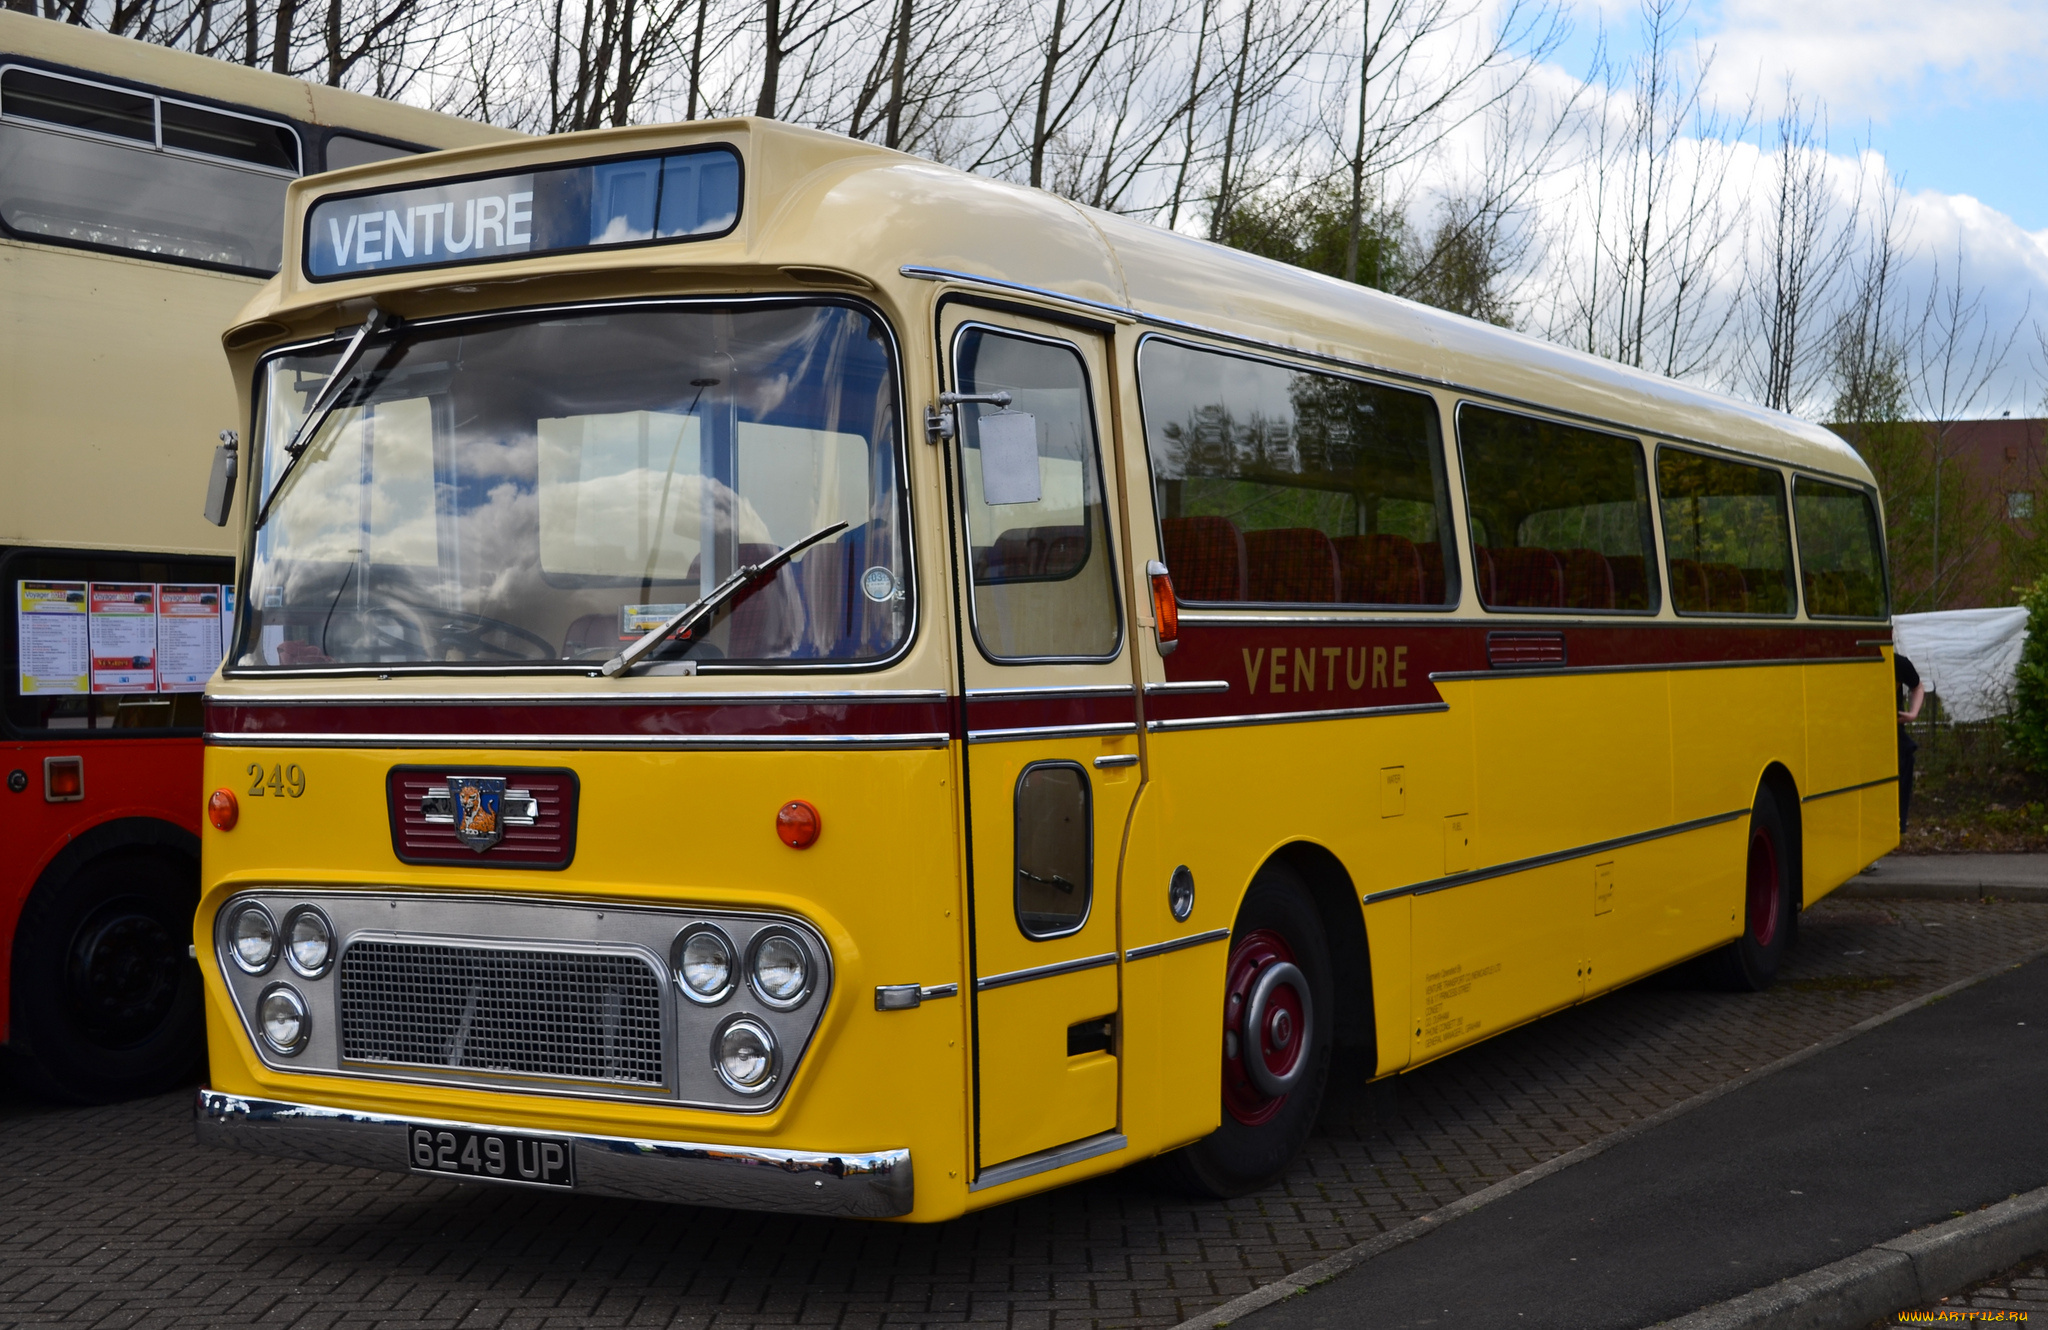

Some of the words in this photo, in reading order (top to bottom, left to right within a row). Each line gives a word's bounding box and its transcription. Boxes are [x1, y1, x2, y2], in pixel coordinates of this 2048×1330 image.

[329, 191, 534, 266] VENTURE
[1242, 646, 1407, 694] VENTURE
[247, 762, 306, 798] 249
[413, 1129, 506, 1175] 6249
[517, 1140, 564, 1180] UP
